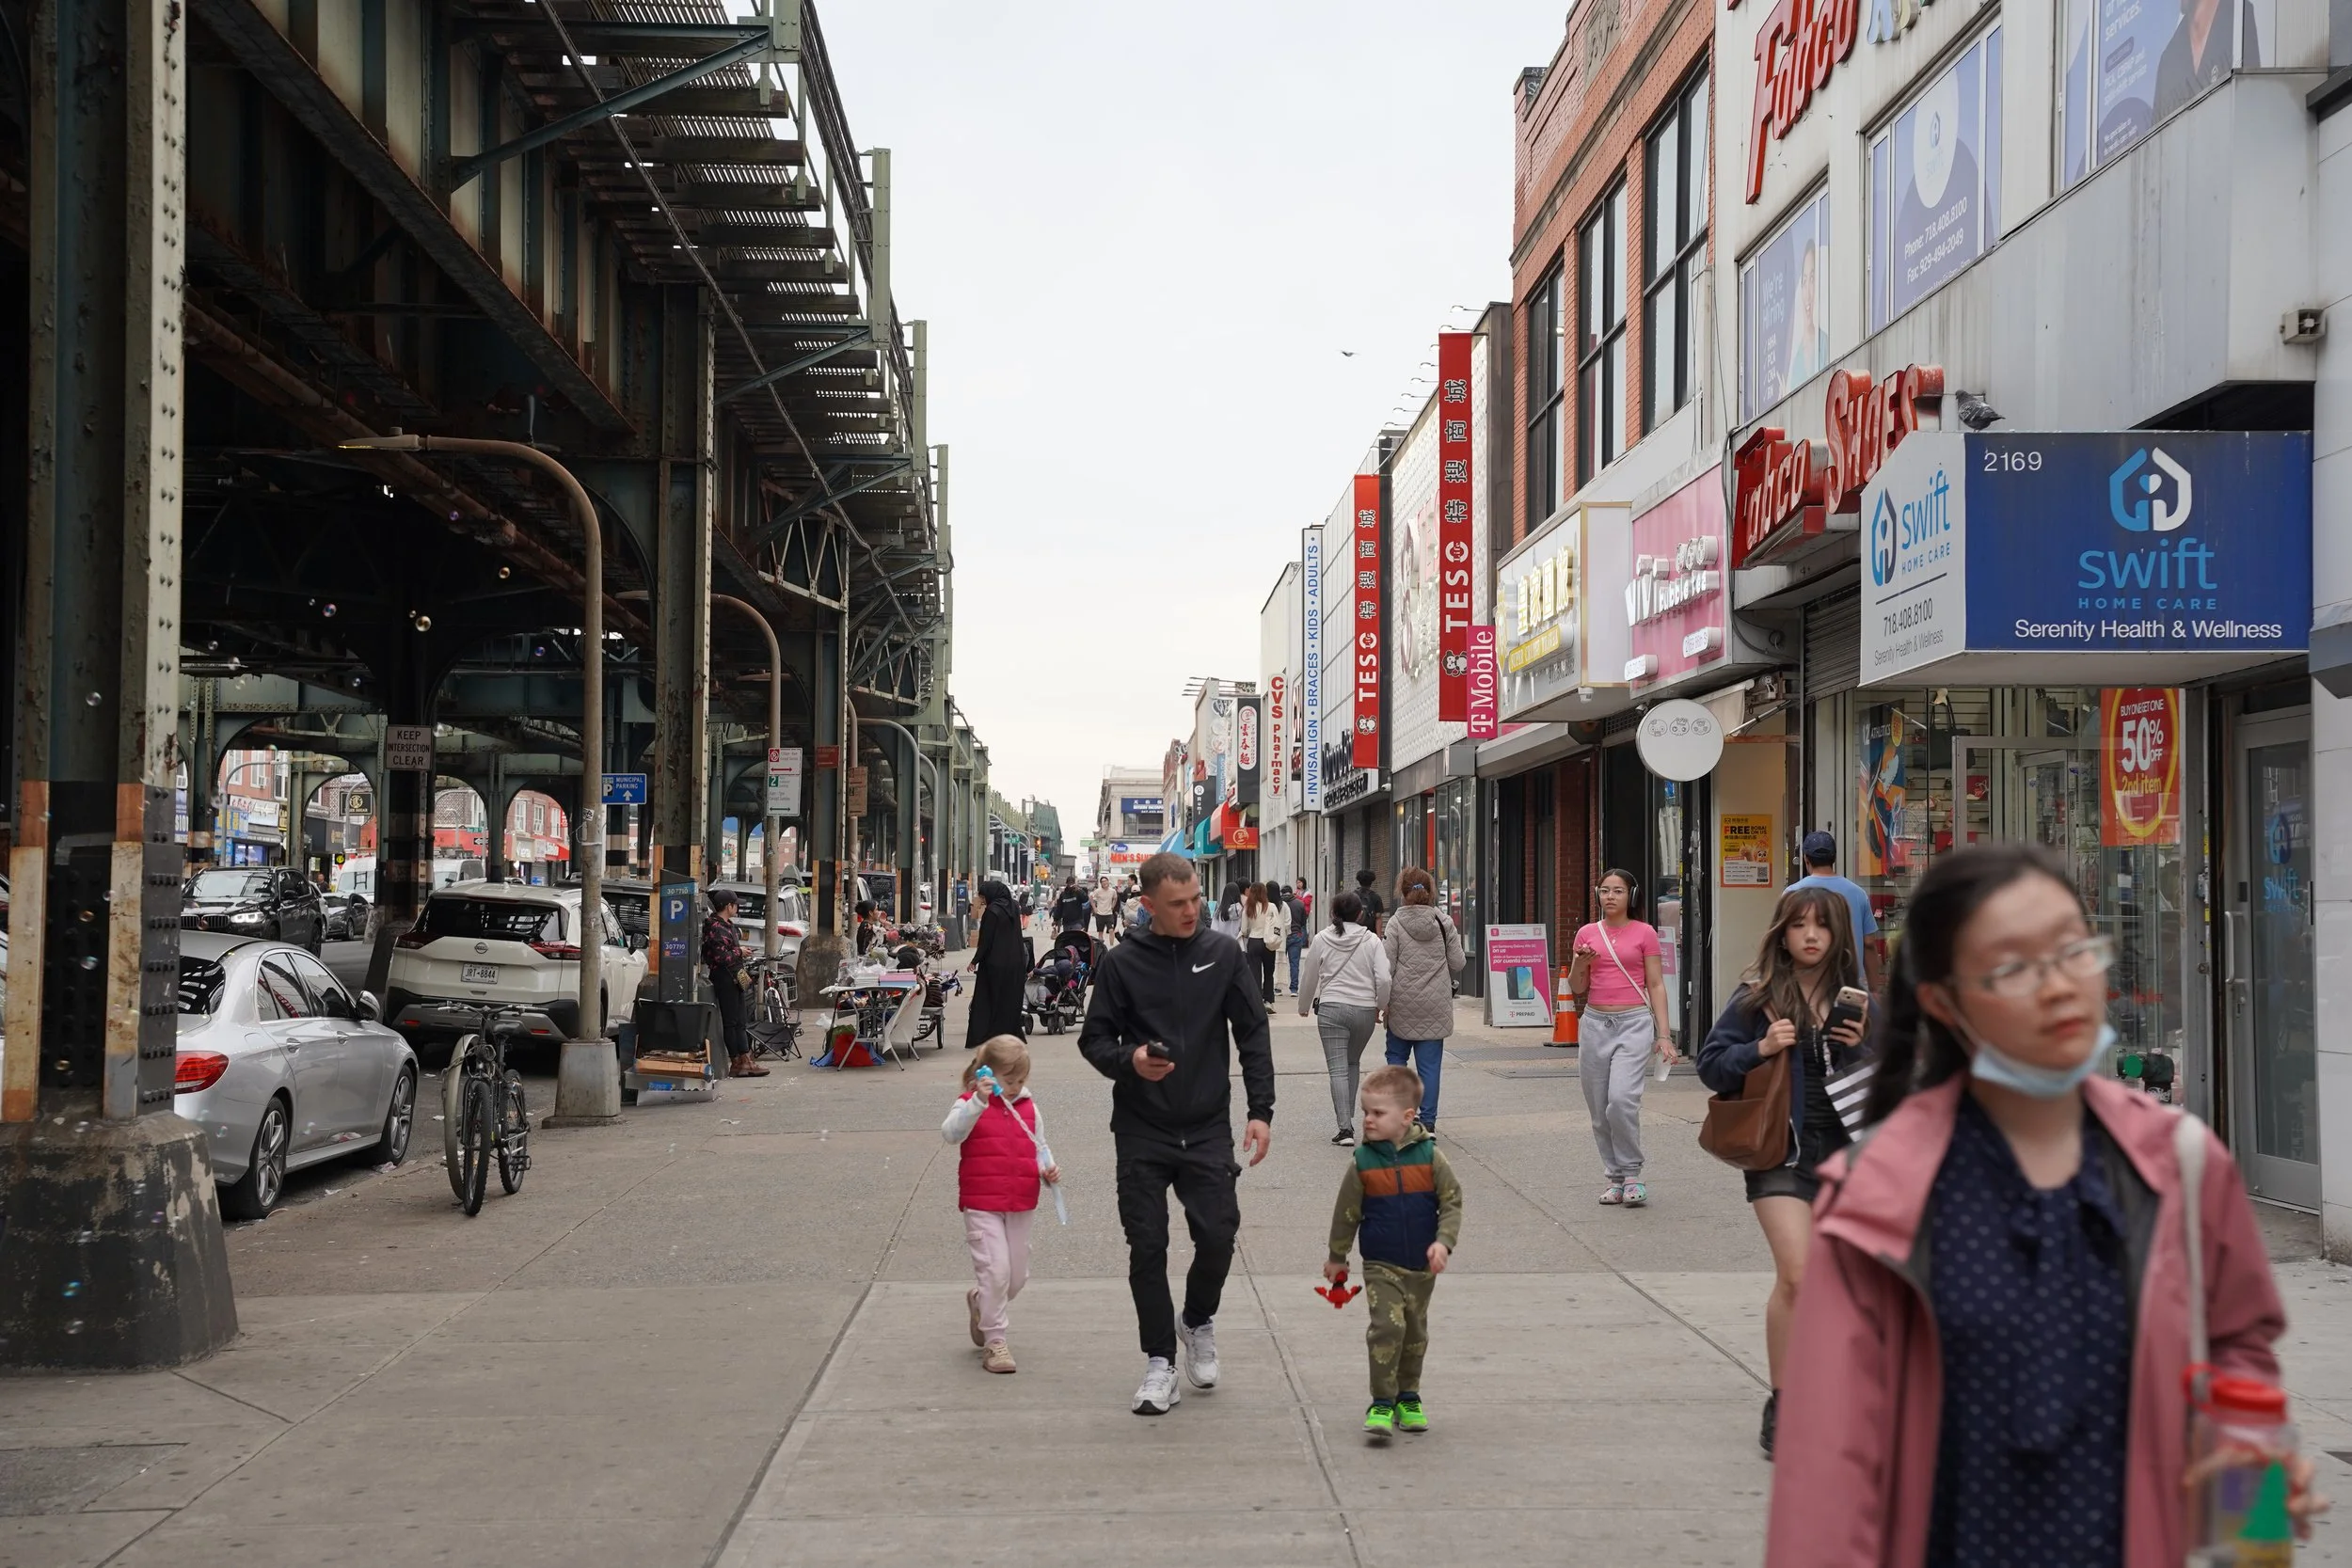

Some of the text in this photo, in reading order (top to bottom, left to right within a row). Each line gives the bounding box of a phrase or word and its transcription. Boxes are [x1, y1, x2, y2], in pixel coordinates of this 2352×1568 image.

[1904, 197, 1967, 261] Phone: 718.408.8100
[1907, 228, 1964, 285] Fax: 929-494-2049
[1762, 271, 1784, 306] We're
[1762, 297, 1785, 330] Hiring
[1445, 379, 1468, 523] 特搜商城
[1983, 451, 2042, 472] 2169
[1902, 469, 1951, 550] swift
[1359, 510, 1377, 619] 特搜商城
[1902, 542, 1950, 575] HOME CARE
[2078, 537, 2218, 590] swift
[1883, 597, 1933, 638] 718.408.8100
[2078, 598, 2217, 610] HOME CARE
[1874, 628, 1944, 666] Serenity Health & Wellness
[2014, 619, 2282, 642] Serenity Health & Wellness
[1308, 545, 1318, 795] INVISALIGN BRACES KIDS ADULTS
[1271, 676, 1284, 720] CVS
[2121, 698, 2164, 717] BUY ONE GET ONE
[387, 743, 430, 752] INTERSECTION
[397, 730, 421, 740] KEEP
[1870, 723, 1891, 739] ATHLETICS
[2122, 717, 2164, 773] 50%
[392, 755, 423, 766] CLEAR
[2150, 748, 2163, 762] OFF
[603, 784, 613, 797] P
[2122, 772, 2163, 797] 2nd item
[1724, 825, 1750, 834] FREE
[2264, 867, 2299, 900] swift
[671, 899, 684, 920] P
